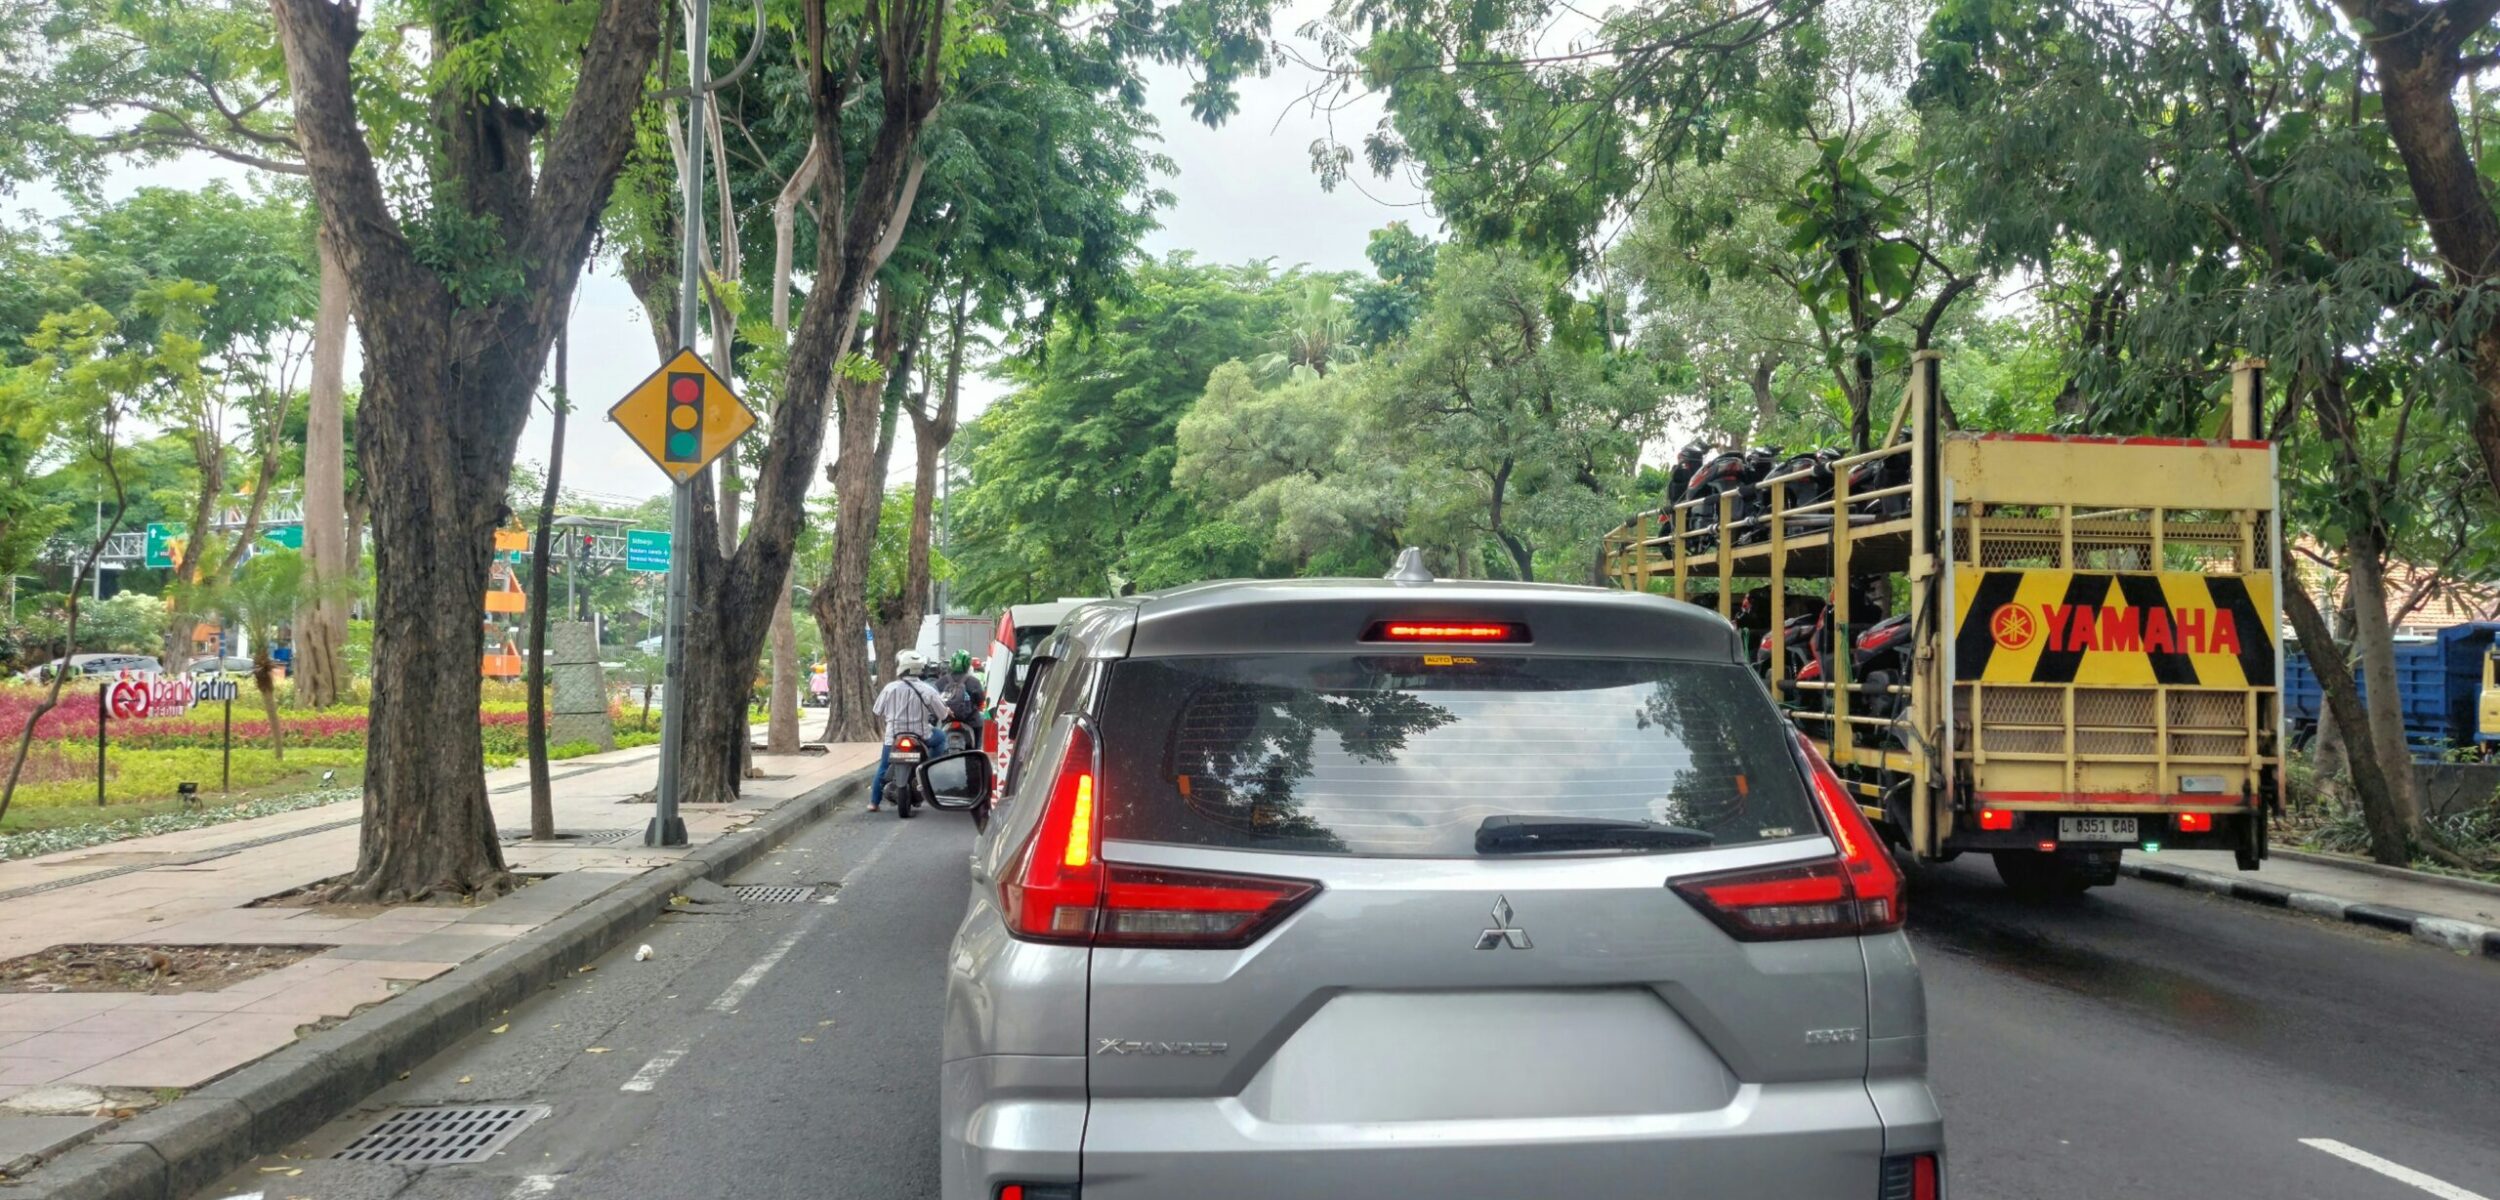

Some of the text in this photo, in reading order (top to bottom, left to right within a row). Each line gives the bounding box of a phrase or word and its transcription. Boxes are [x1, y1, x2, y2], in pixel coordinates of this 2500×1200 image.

[2041, 604, 2241, 654] YAMAHA
[2062, 820, 2069, 833] L
[1096, 1038, 1228, 1055] XPANDER
